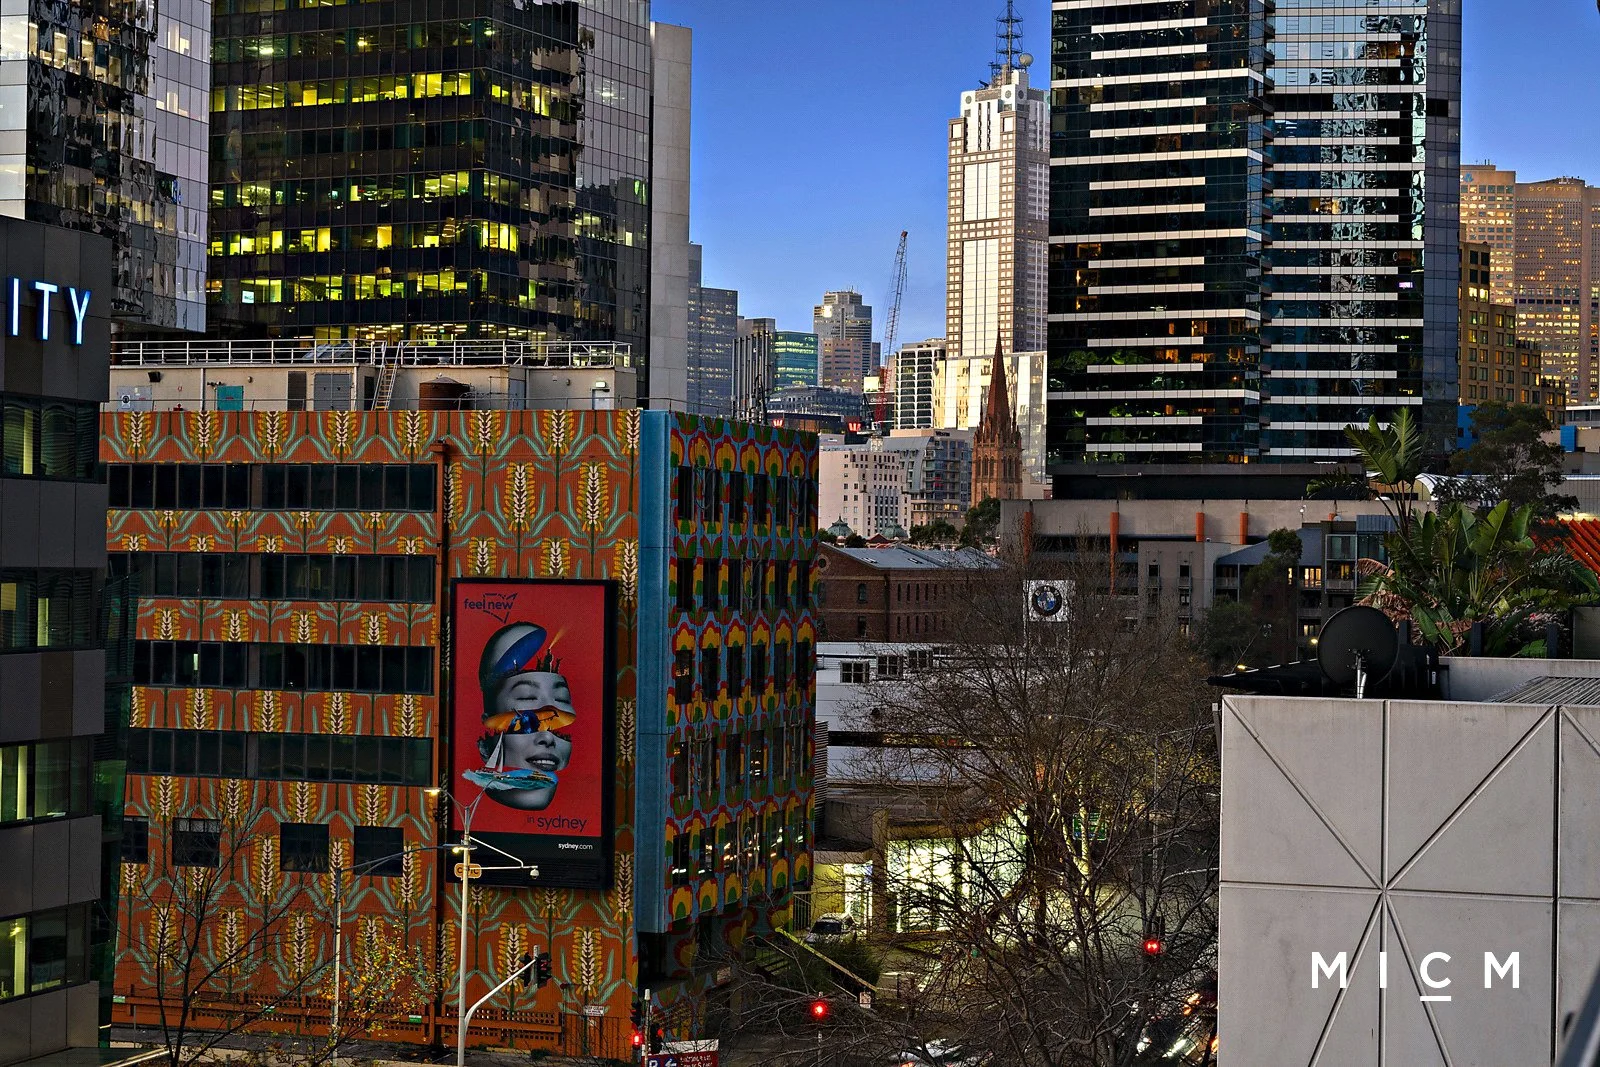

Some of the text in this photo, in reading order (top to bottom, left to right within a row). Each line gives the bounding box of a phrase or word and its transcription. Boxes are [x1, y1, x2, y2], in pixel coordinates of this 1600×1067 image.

[464, 598, 514, 610] feel new
[527, 814, 587, 832] in sydney
